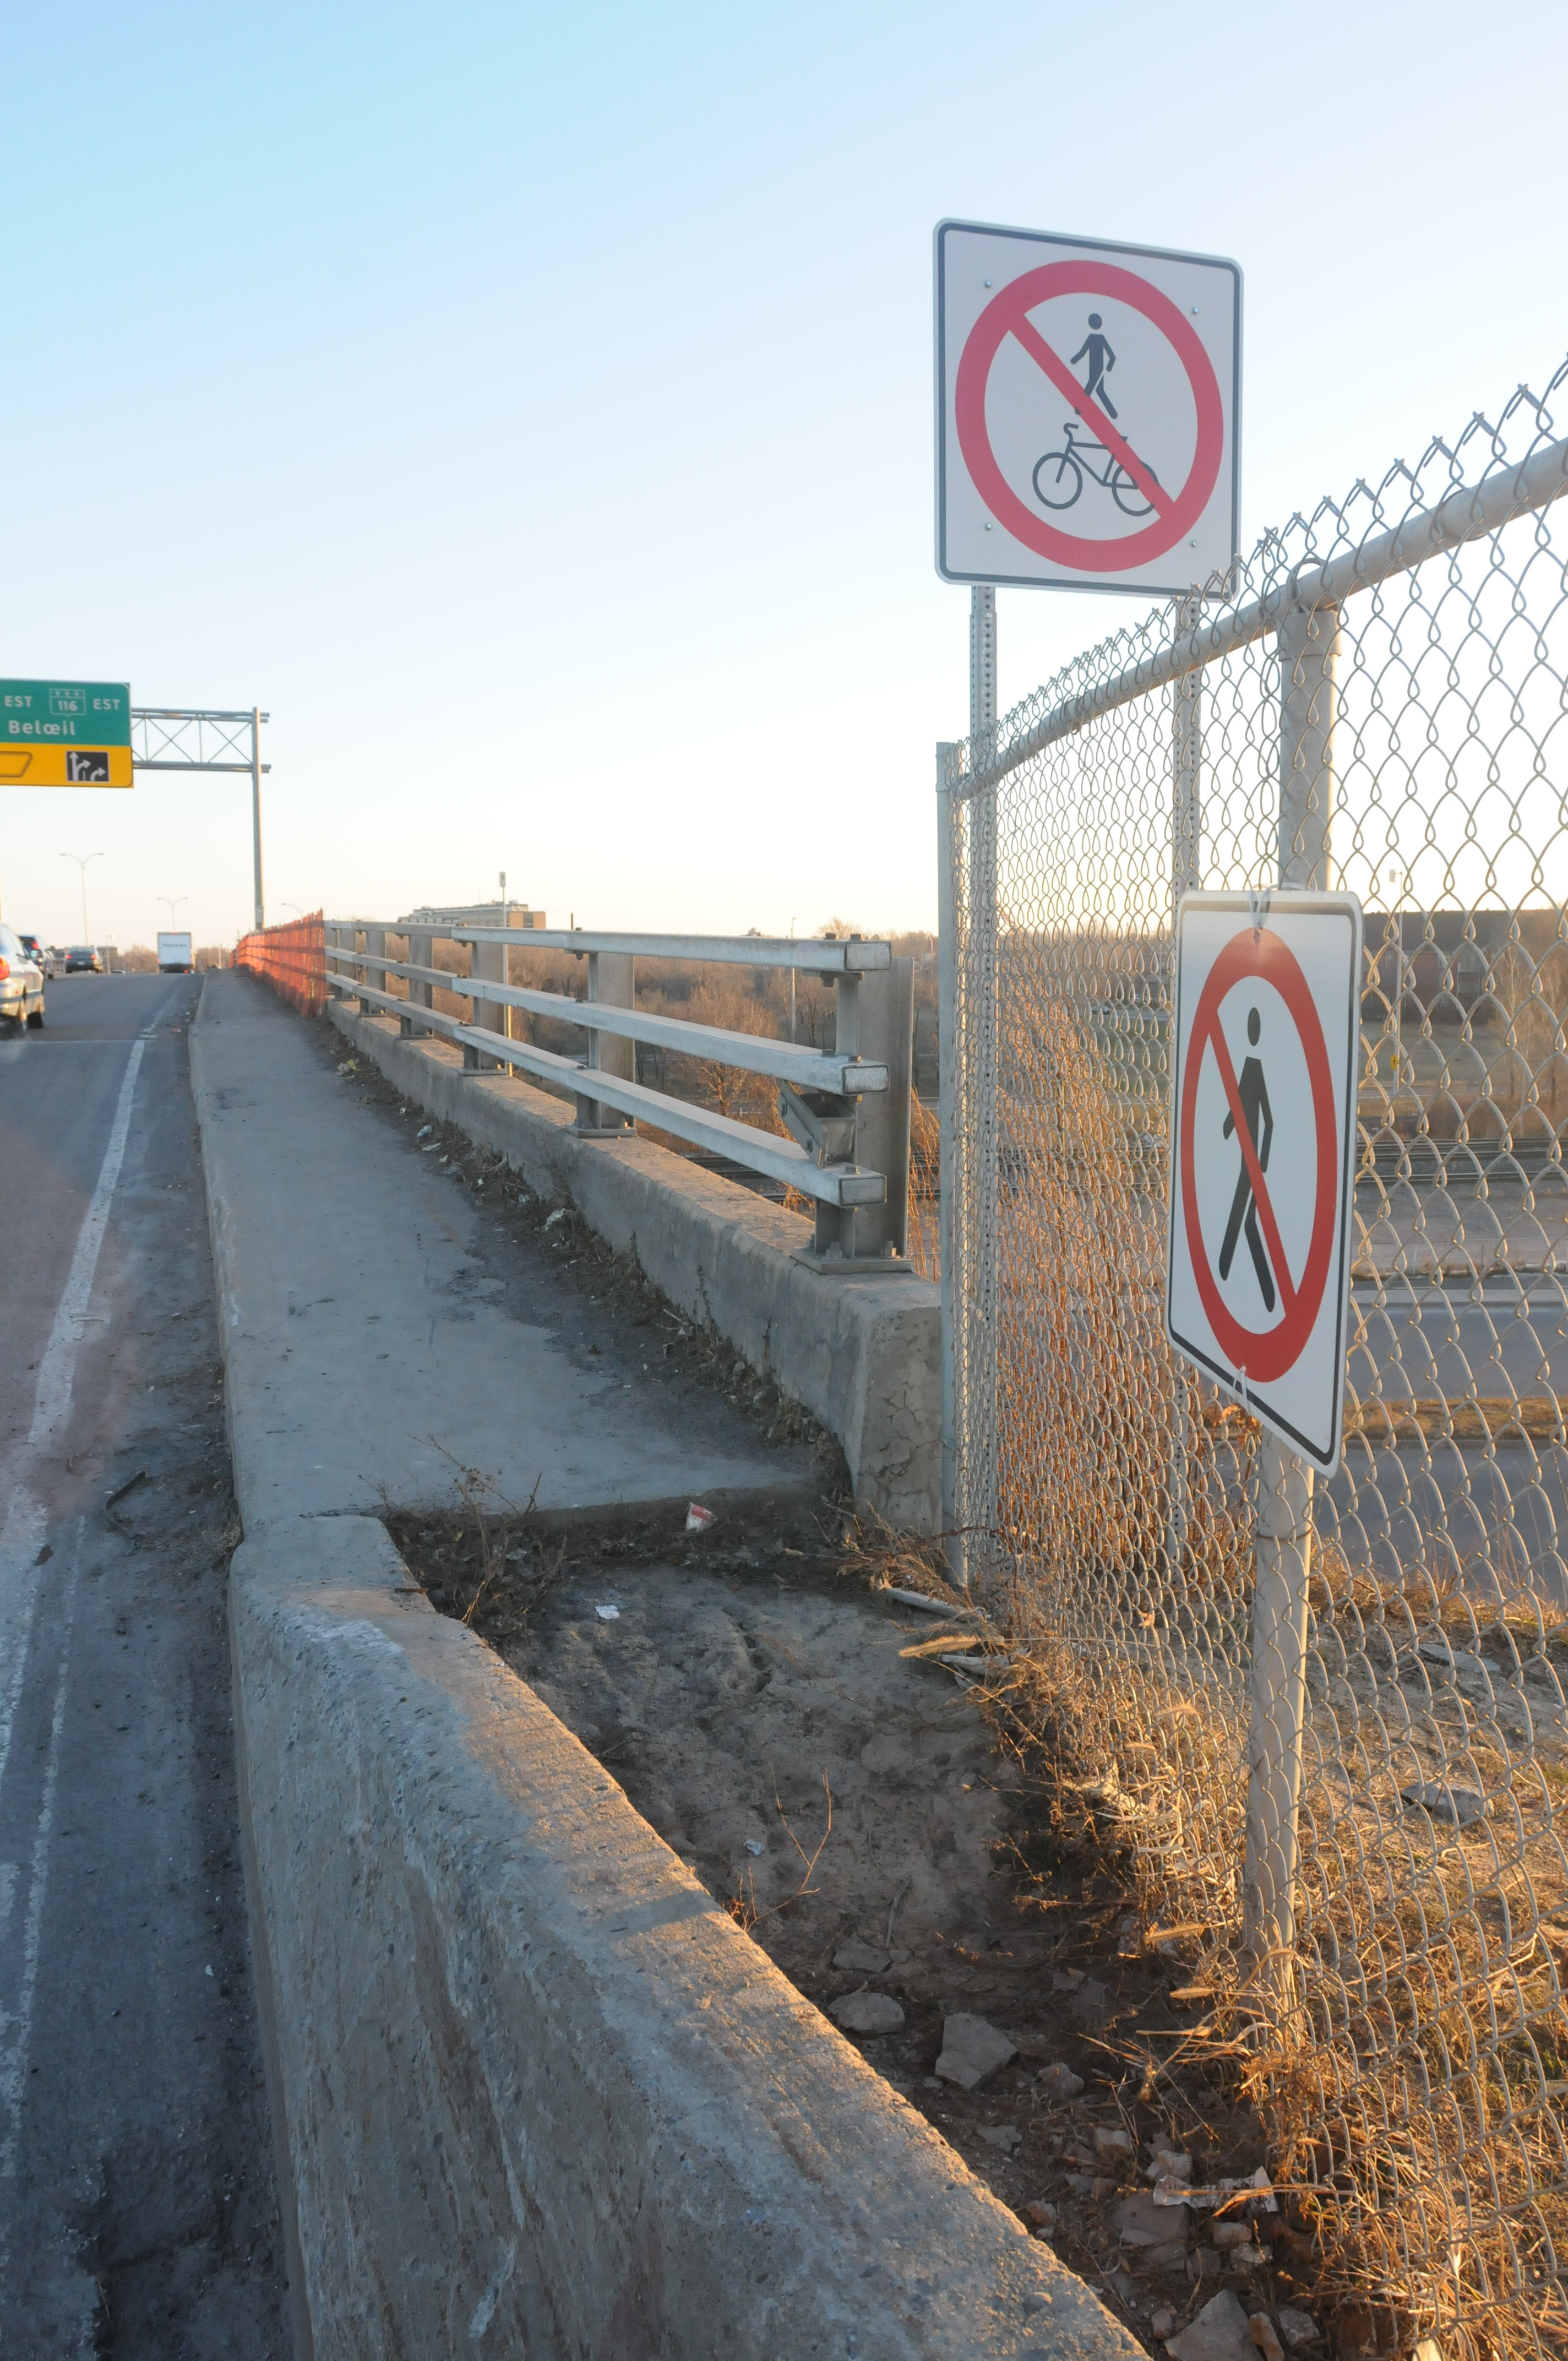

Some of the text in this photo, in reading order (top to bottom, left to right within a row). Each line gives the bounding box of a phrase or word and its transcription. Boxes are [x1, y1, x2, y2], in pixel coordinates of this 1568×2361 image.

[4, 695, 121, 711] EST 116 EST
[8, 720, 76, 736] Belœil
